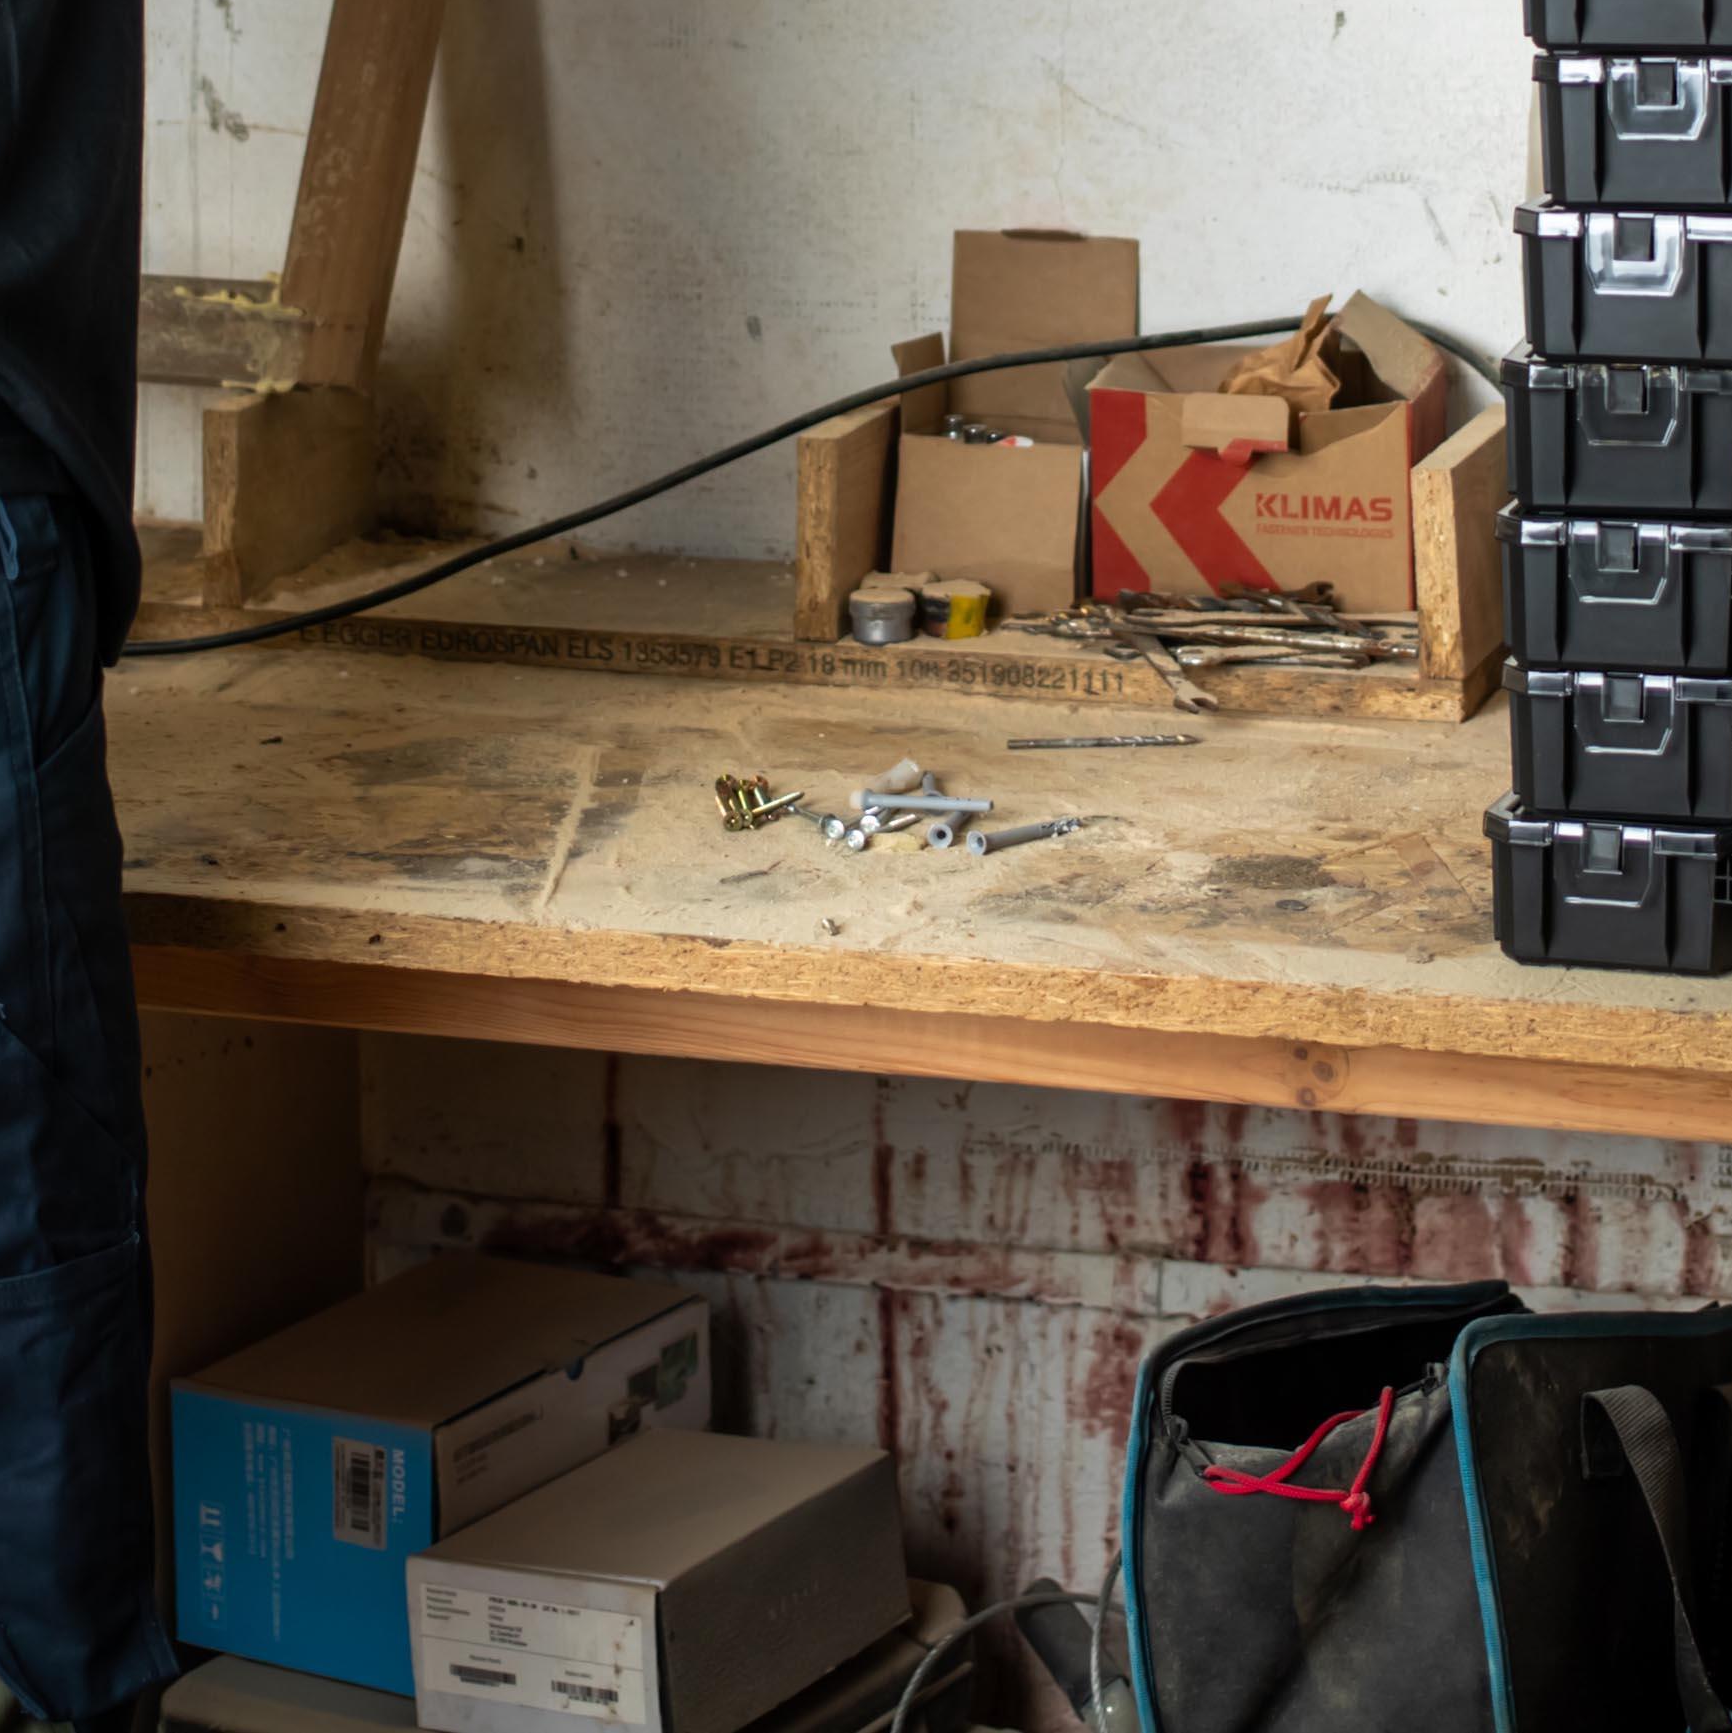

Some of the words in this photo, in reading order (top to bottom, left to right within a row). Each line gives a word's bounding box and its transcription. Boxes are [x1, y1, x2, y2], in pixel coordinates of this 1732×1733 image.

[1256, 493, 1394, 522] KLIMAS
[323, 623, 412, 648] EGGER
[420, 628, 559, 656] EUROSPAN
[808, 652, 836, 676] 18
